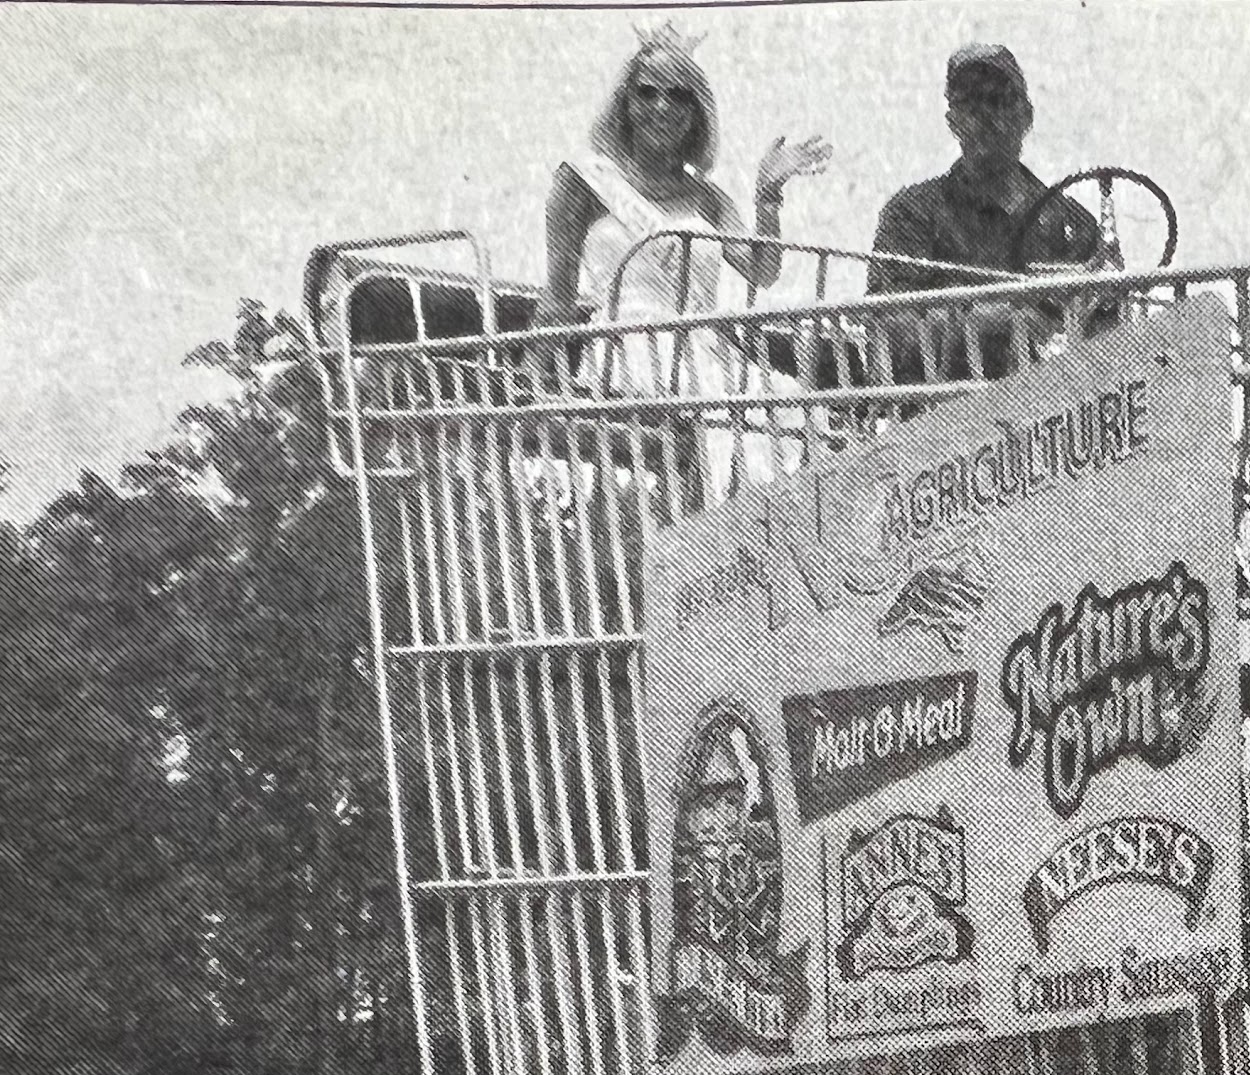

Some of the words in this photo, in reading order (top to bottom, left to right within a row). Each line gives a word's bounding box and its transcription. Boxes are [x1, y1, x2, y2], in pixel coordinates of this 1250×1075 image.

[881, 379, 1150, 554] AGRICULTURE
[1005, 570, 1203, 757] Nature's
[1049, 671, 1156, 802] Own
[1039, 821, 1198, 912] NEESE'S
